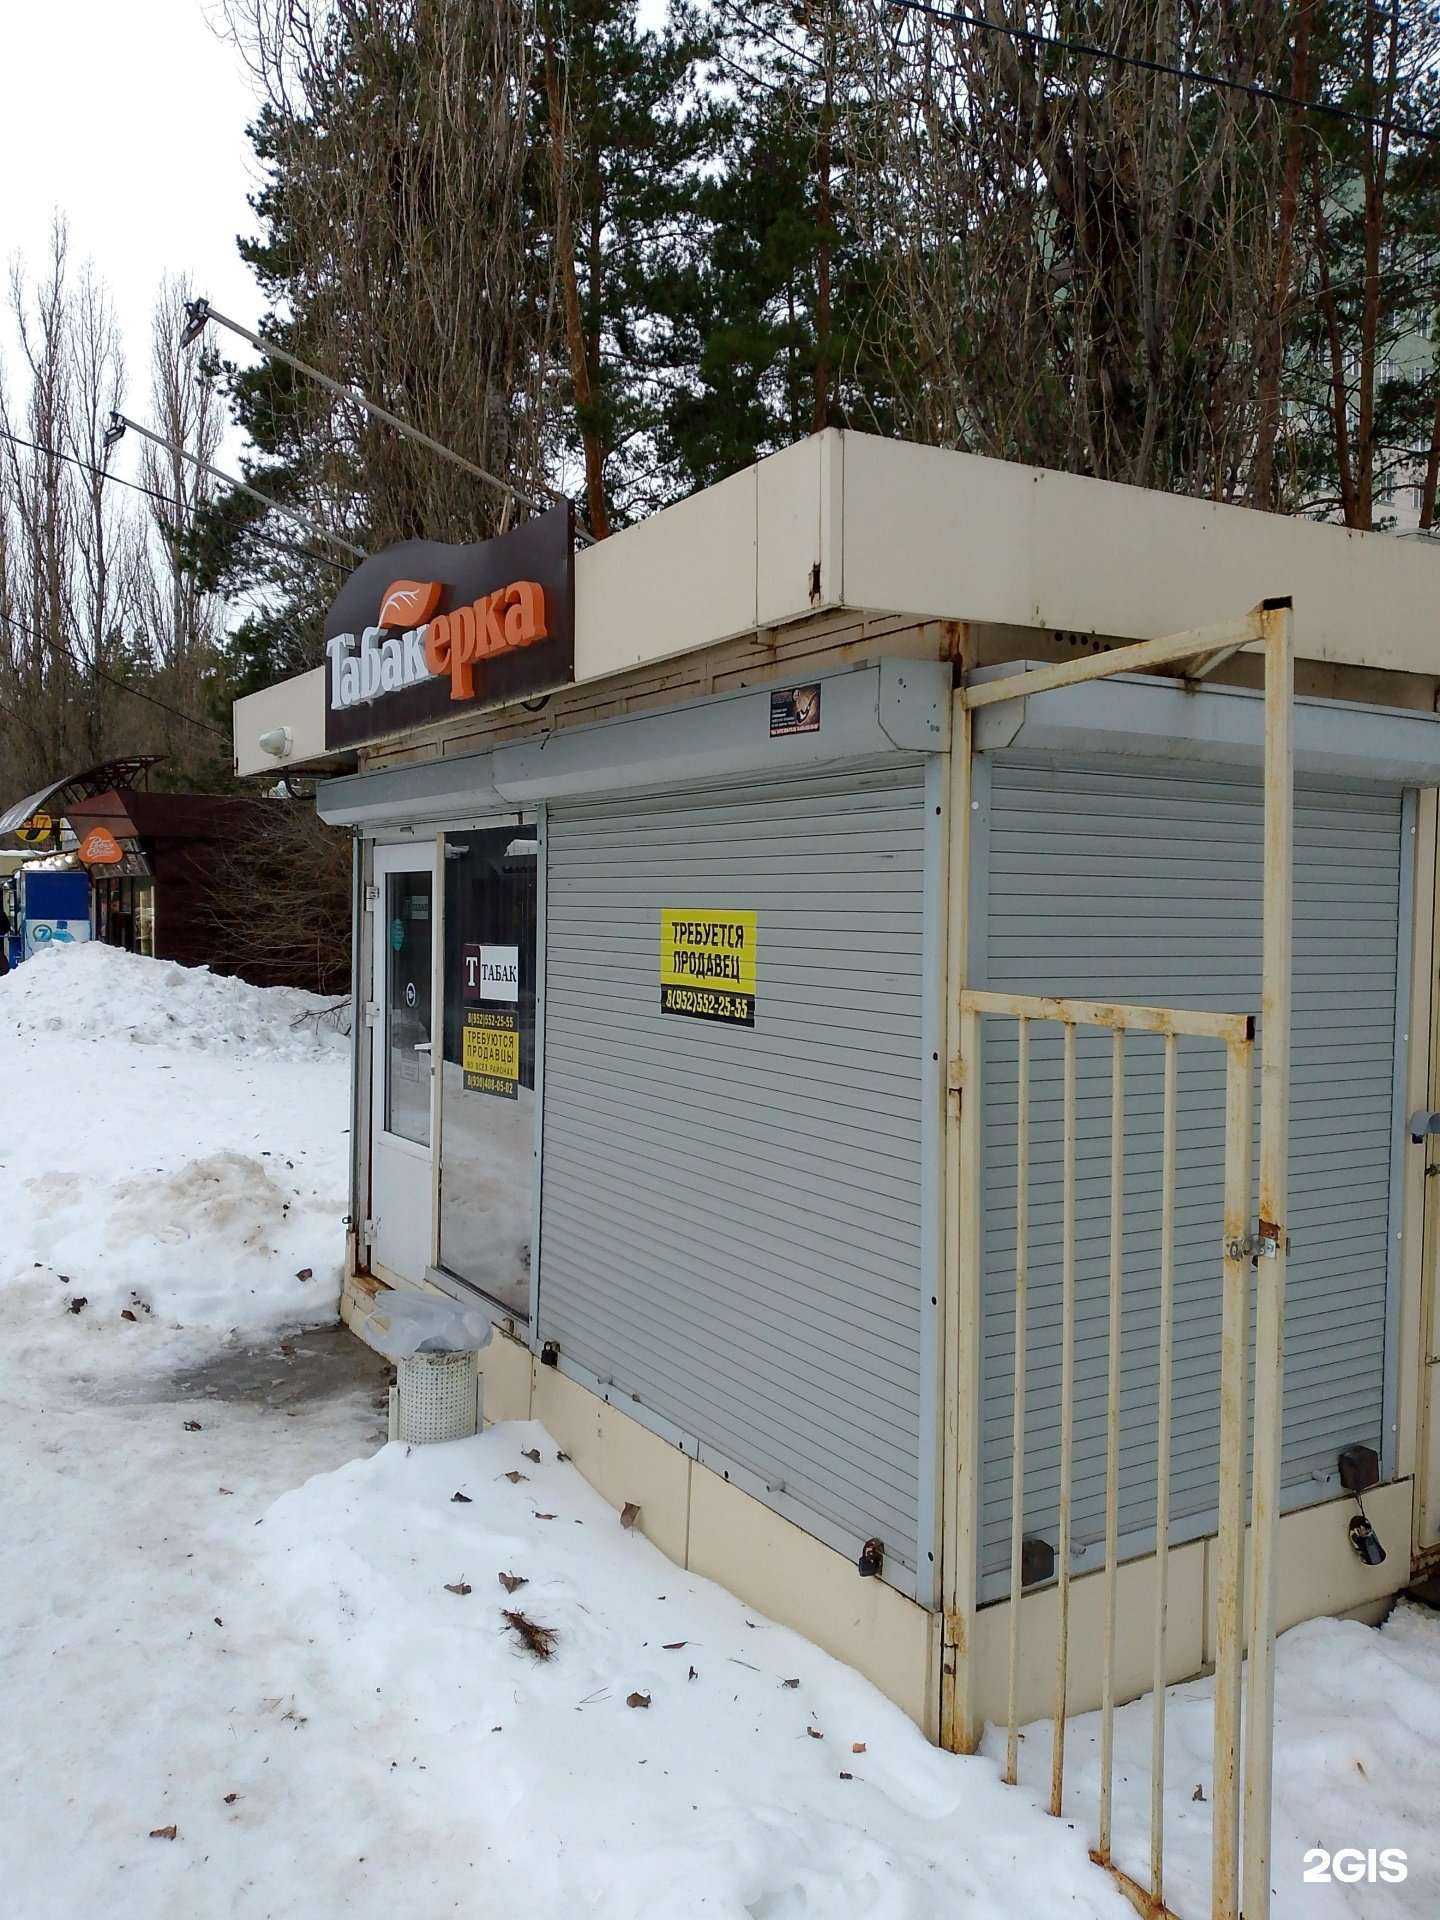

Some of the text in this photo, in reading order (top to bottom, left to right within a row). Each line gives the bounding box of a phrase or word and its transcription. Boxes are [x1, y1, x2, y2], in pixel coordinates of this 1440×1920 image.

[326, 580, 548, 710] Табакерка
[671, 921, 744, 950] ТРЕБУЕТСЯ
[481, 963, 517, 983] ТАБАК
[673, 950, 741, 984] ПРОДАВЕЦ
[665, 989, 748, 1019] 8(952)552-25-55
[466, 1044, 514, 1064] ПРОДАВЦЫ
[467, 1030, 514, 1049] ТРЕБУЮТСЯ
